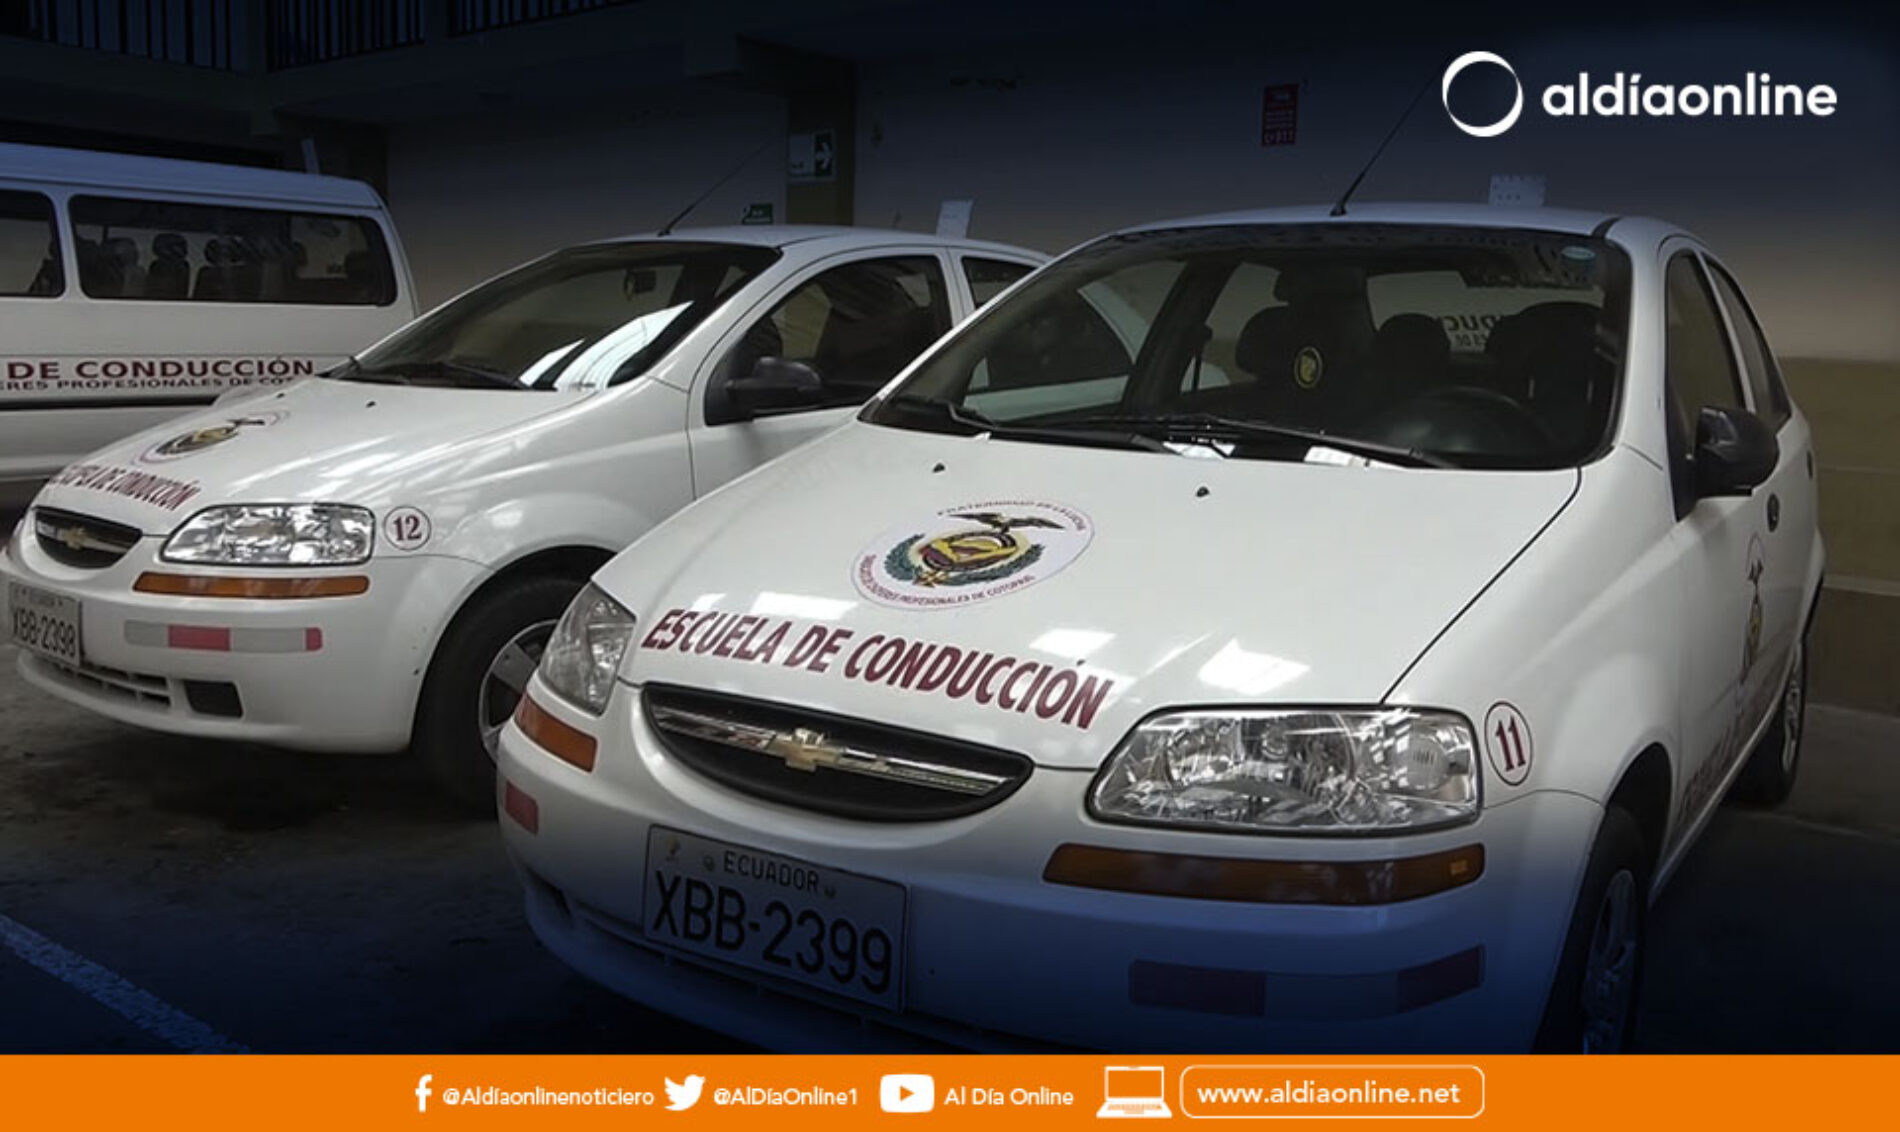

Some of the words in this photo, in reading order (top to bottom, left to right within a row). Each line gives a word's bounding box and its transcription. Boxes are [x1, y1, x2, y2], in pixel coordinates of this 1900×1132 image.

[7, 361, 60, 379] DE
[75, 355, 313, 378] CONDUCCIÓN
[57, 377, 222, 389] PROFESIONALES
[392, 514, 422, 541] 12
[641, 609, 792, 664] ESCUELA
[783, 624, 854, 672] DE
[845, 634, 1115, 730] CONDUCCIÓN
[1495, 714, 1526, 772] 11
[723, 850, 820, 892] ECUADOR
[653, 870, 893, 995] XBB-2399
